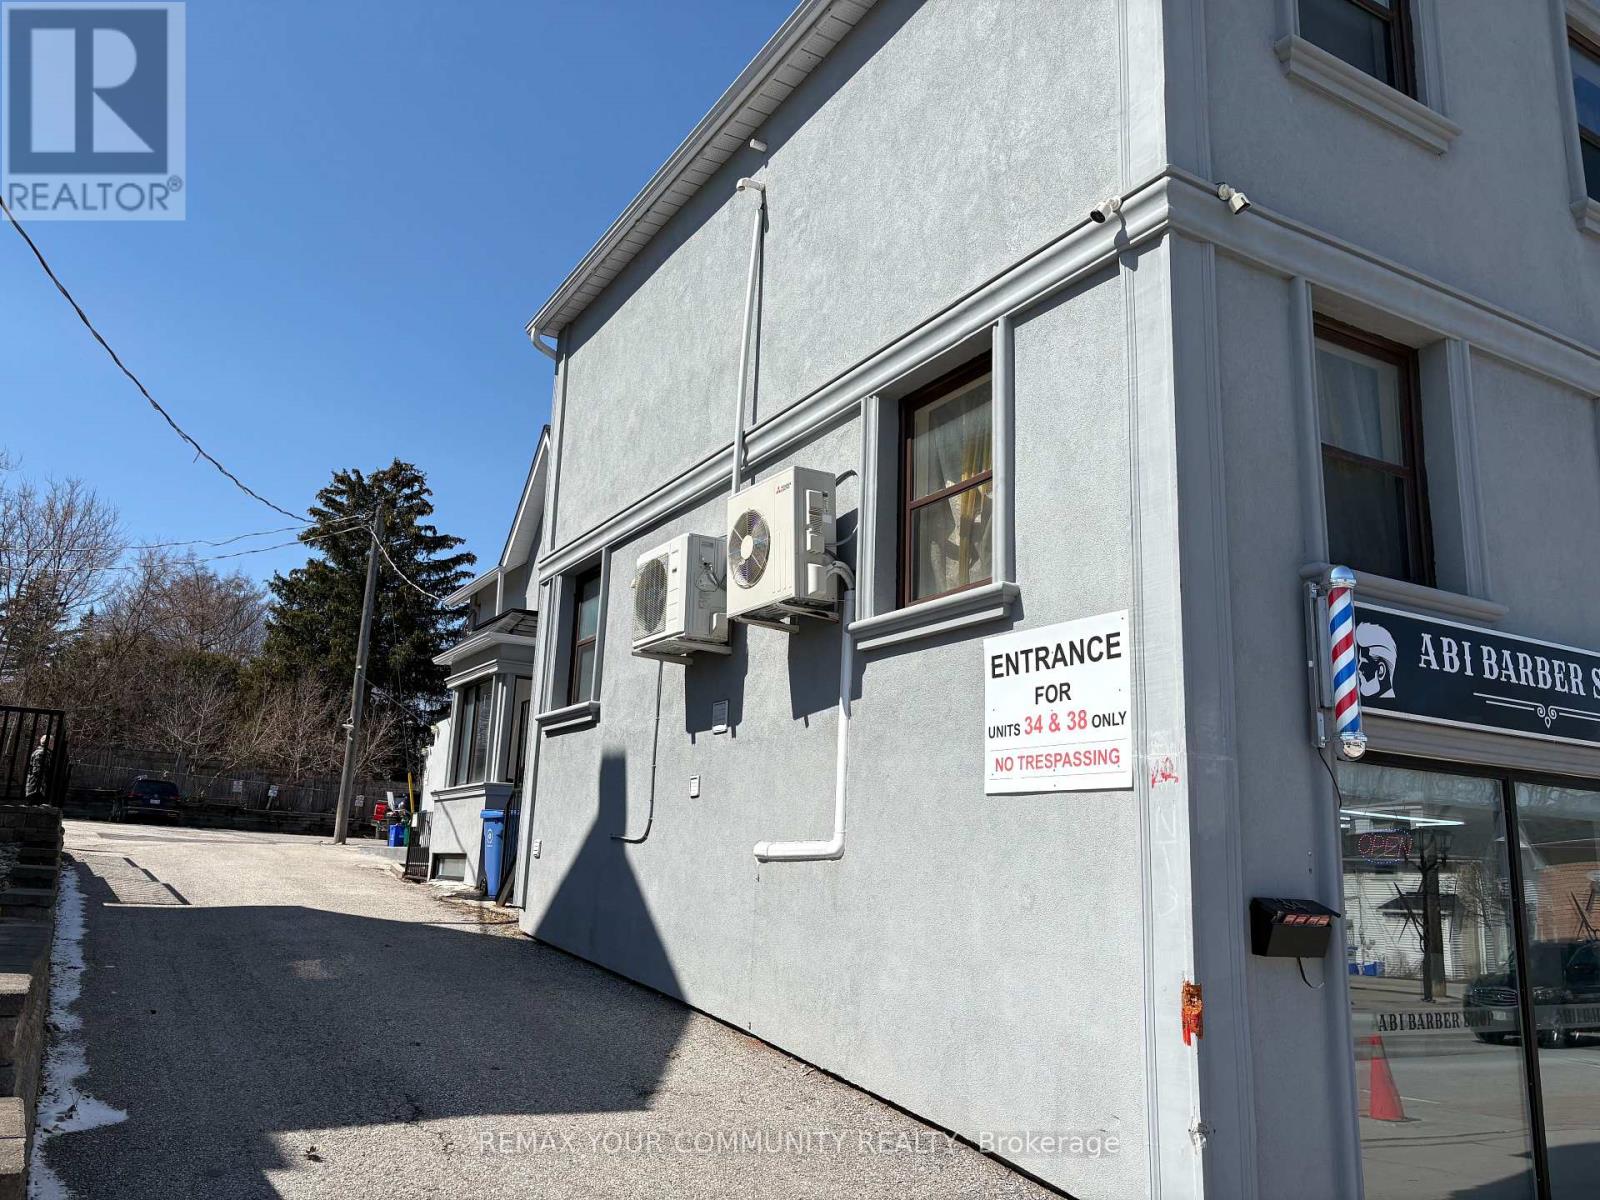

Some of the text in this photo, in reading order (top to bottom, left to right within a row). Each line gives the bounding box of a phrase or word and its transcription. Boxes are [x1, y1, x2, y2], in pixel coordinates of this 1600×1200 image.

[990, 631, 1122, 679] ENTRANCE
[1418, 633, 1474, 677] ABI
[1479, 645, 1587, 696] BARBER
[1034, 682, 1072, 705] FOR
[988, 709, 1127, 739] UNITS 34 & 38 ONLY
[995, 748, 1121, 772] NO TRESPASSING
[1358, 834, 1412, 857] OPEN
[1378, 1013, 1405, 1031] ABI
[1408, 1011, 1461, 1030] BARBER
